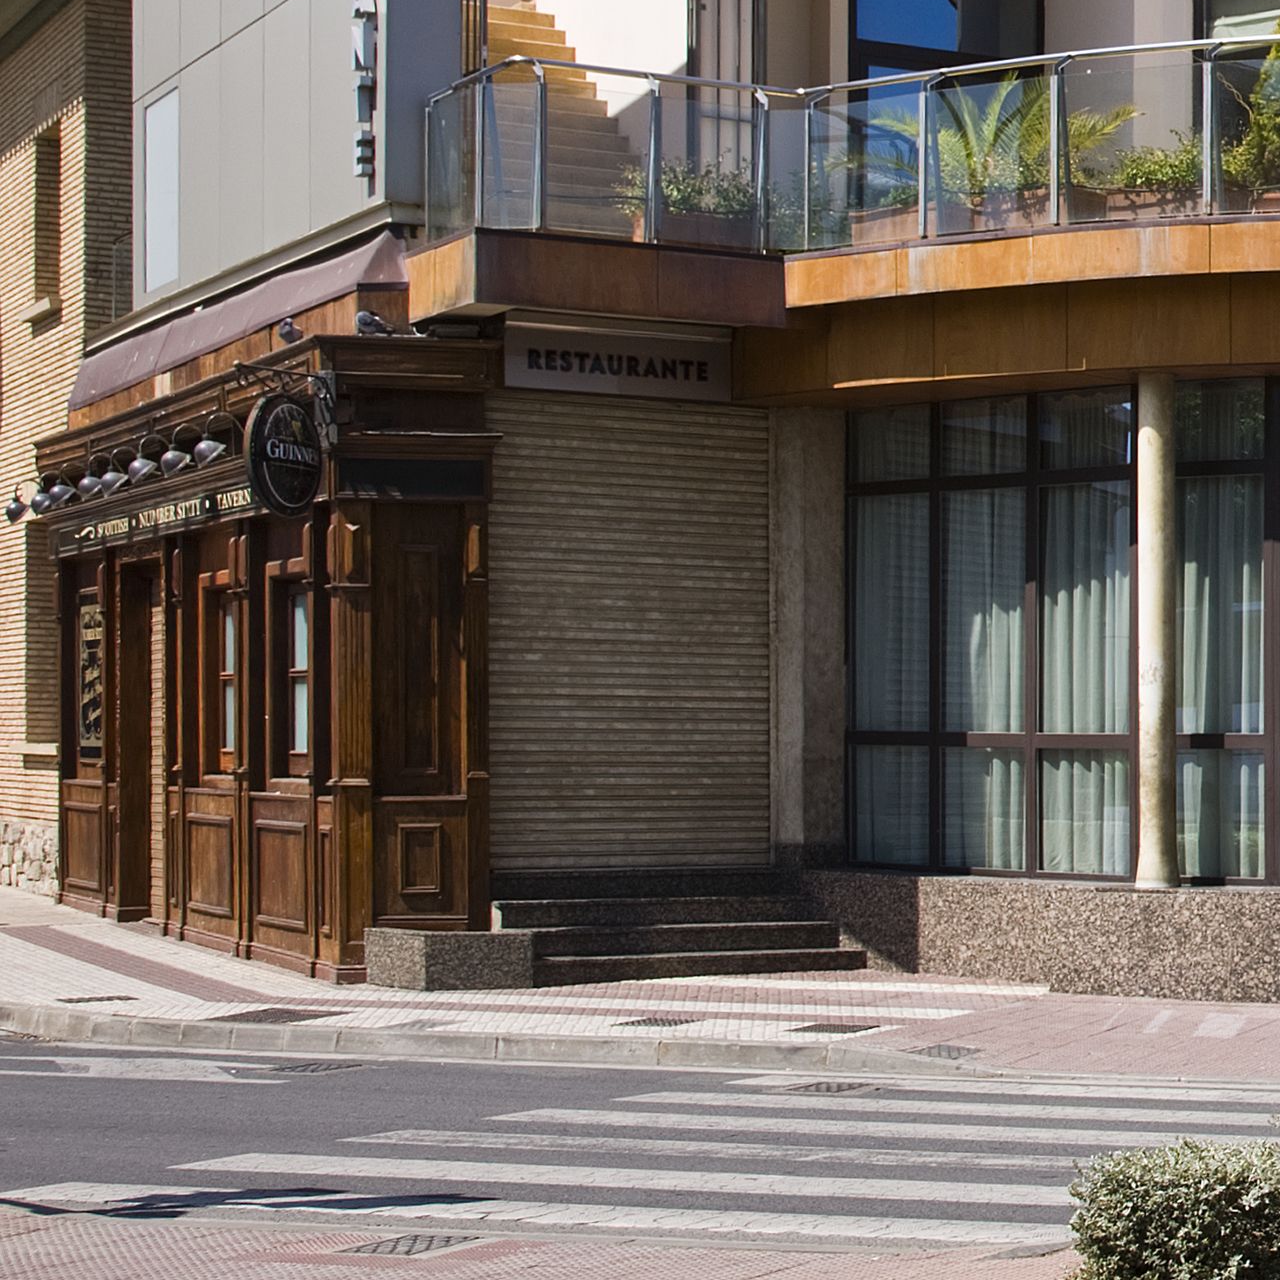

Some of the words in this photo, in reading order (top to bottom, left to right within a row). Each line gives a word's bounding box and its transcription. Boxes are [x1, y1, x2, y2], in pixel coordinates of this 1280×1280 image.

[526, 347, 710, 383] RESTAURANTE
[266, 438, 318, 466] GUINNE
[96, 517, 130, 538] SCOTTISH
[138, 505, 176, 529] NUMBER
[176, 499, 202, 520] SIXTY
[215, 487, 252, 510] TAVERN
